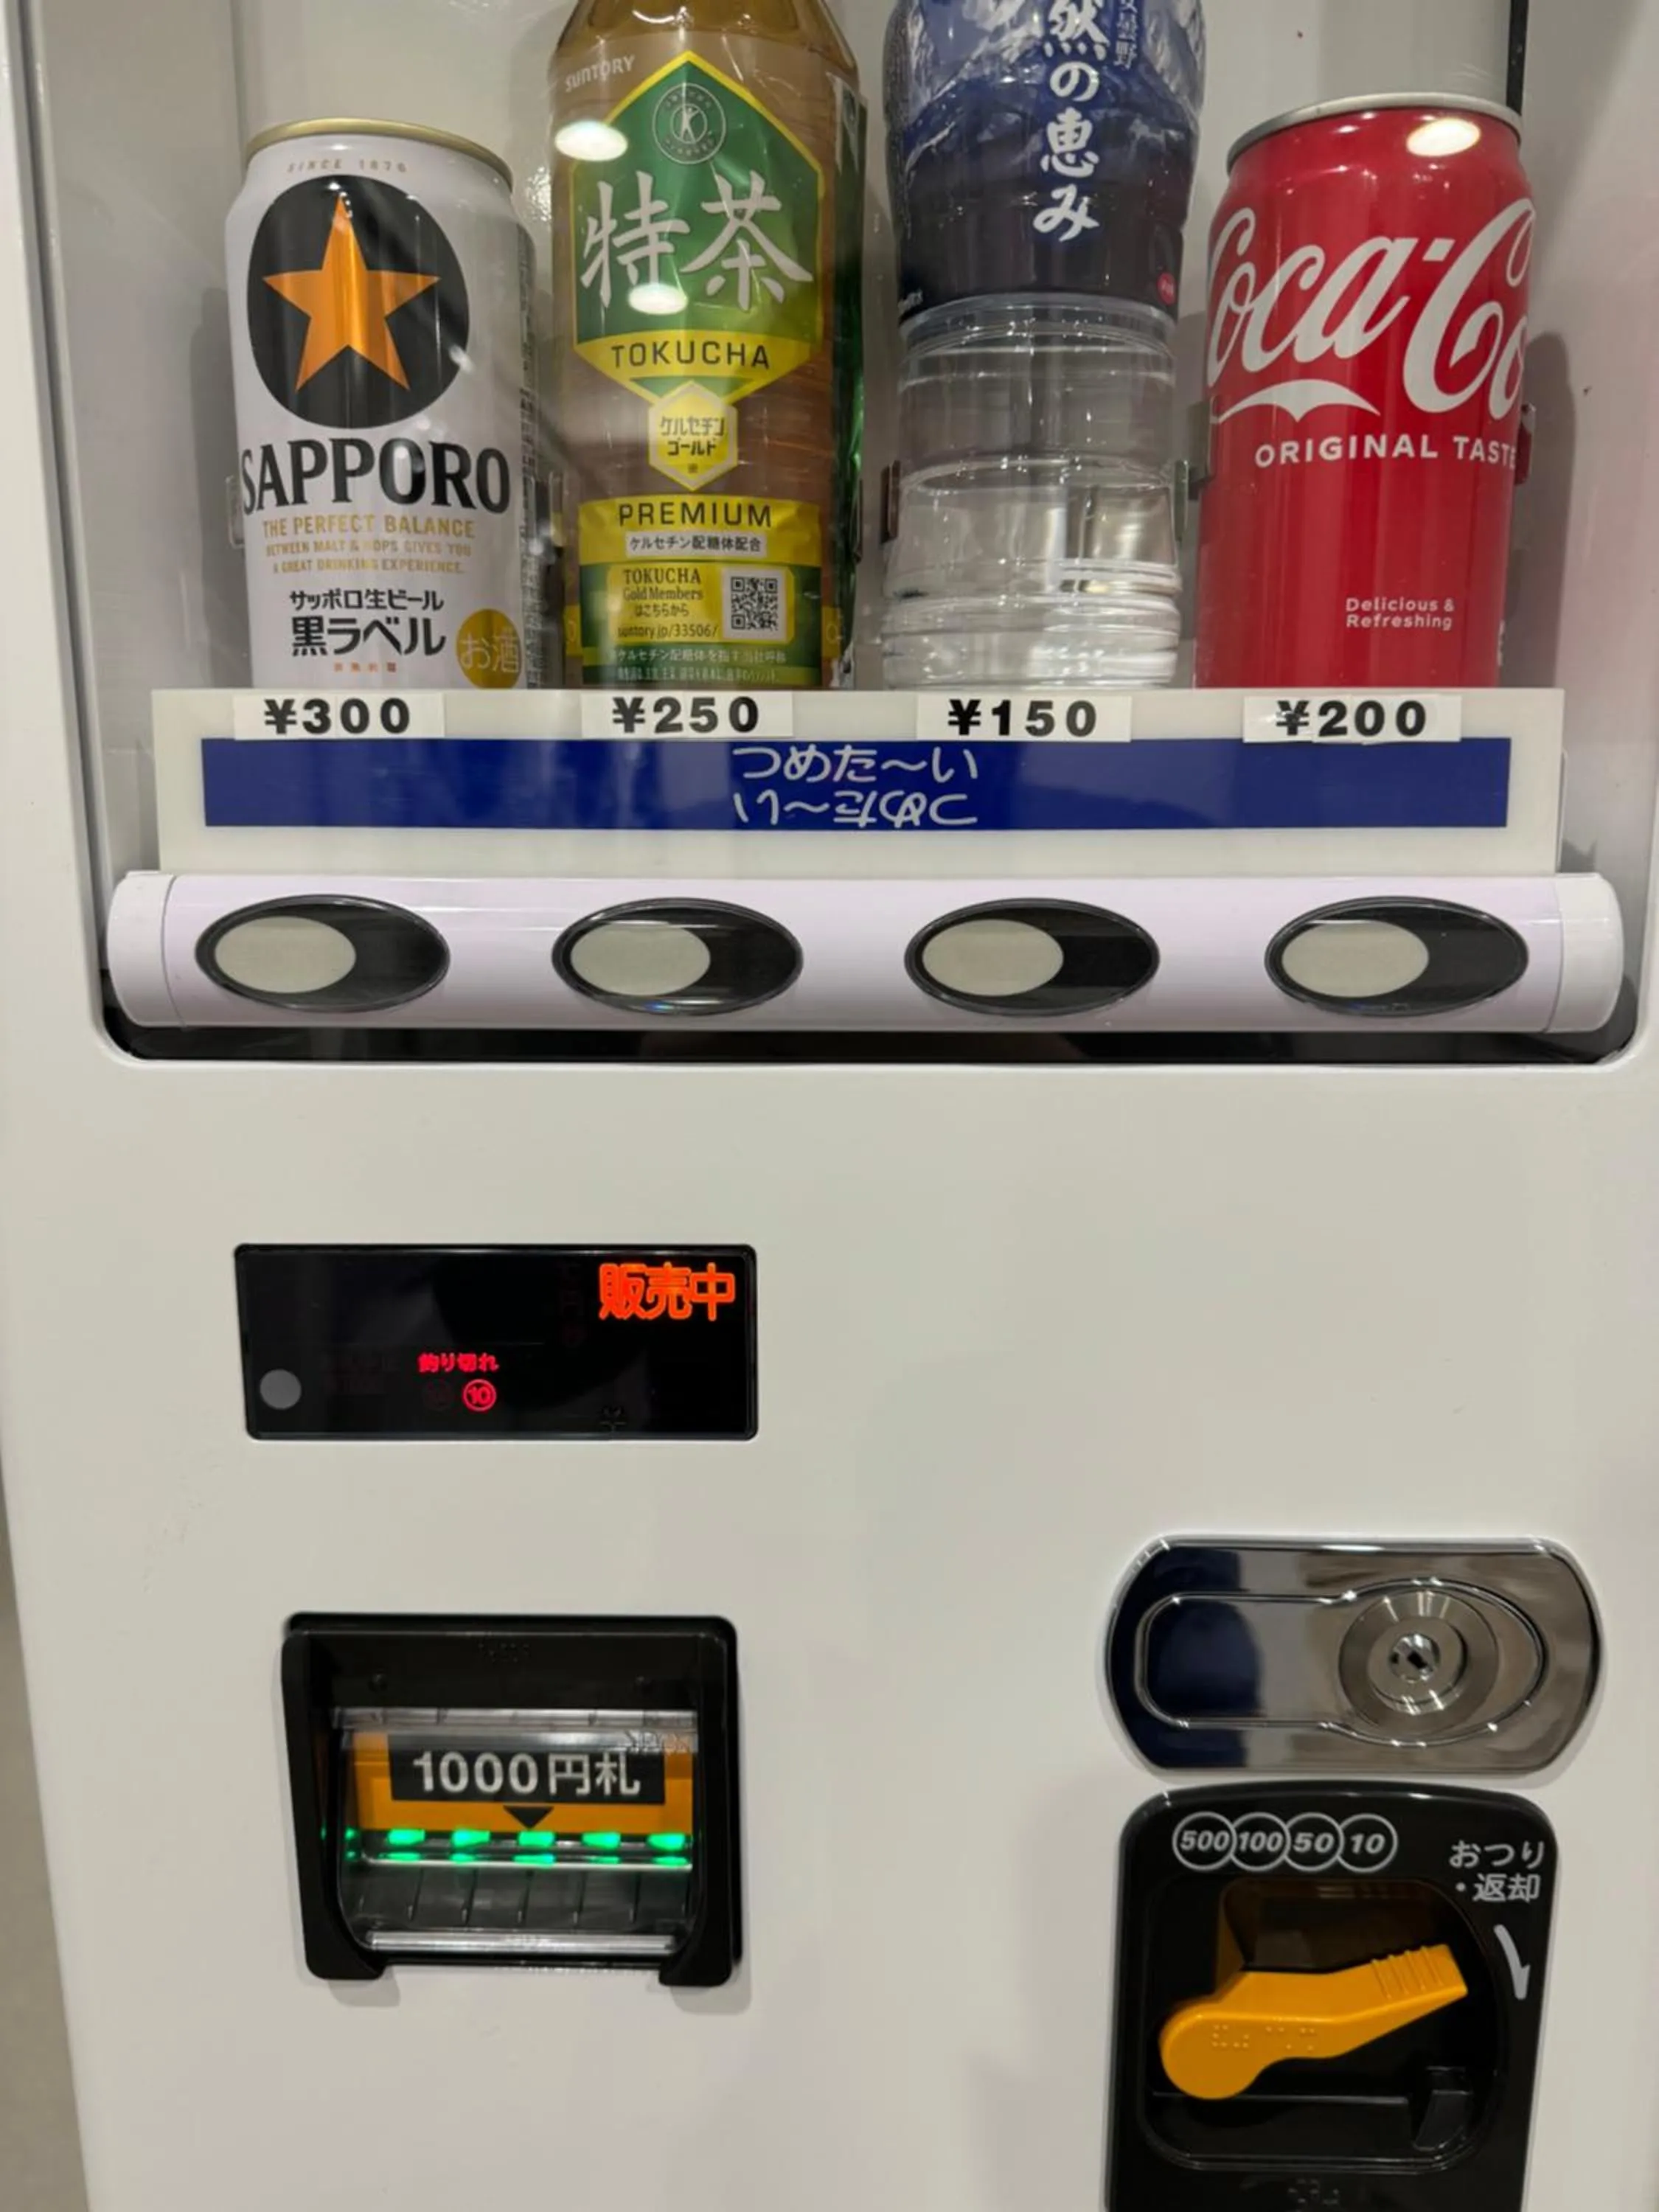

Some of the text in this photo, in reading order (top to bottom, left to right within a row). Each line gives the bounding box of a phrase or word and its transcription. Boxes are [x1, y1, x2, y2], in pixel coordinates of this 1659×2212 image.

[565, 54, 636, 93] SUNTORY
[580, 170, 813, 312] 特茶
[611, 340, 770, 369] TOKUCHA
[660, 416, 725, 437] ケルセチン
[667, 438, 717, 456] ゴールド
[1254, 433, 1516, 470] ORIGINAL TASTE
[241, 437, 510, 515] SAPPORO
[262, 515, 476, 539] THE PERFECT BALANCE
[619, 502, 771, 528] PREMIUM
[313, 540, 347, 553] MALT
[403, 541, 442, 554] GIVES
[448, 543, 472, 557] YOU
[629, 535, 762, 553] ケルセチン配糖体配合
[623, 568, 701, 585] TOKUCHA
[290, 588, 445, 611] サッポロ生ビール
[623, 585, 703, 600] Gold Members
[1346, 597, 1455, 612] Delicious &
[635, 603, 689, 617] はこちらから
[1346, 614, 1452, 630] Refreshing
[291, 616, 446, 656] 黒ラベル
[458, 626, 520, 673] お酒
[264, 698, 410, 734] ¥300
[612, 696, 759, 733] ¥250
[947, 699, 1097, 737] ¥150
[1276, 700, 1427, 737] ¥200
[598, 1262, 735, 1321] 販売中
[417, 1353, 499, 1373] 釣り切れ
[413, 1750, 641, 1797] 1000円札
[1180, 1831, 1385, 1854] 500 100 50 10
[1449, 1840, 1544, 1869] おつり
